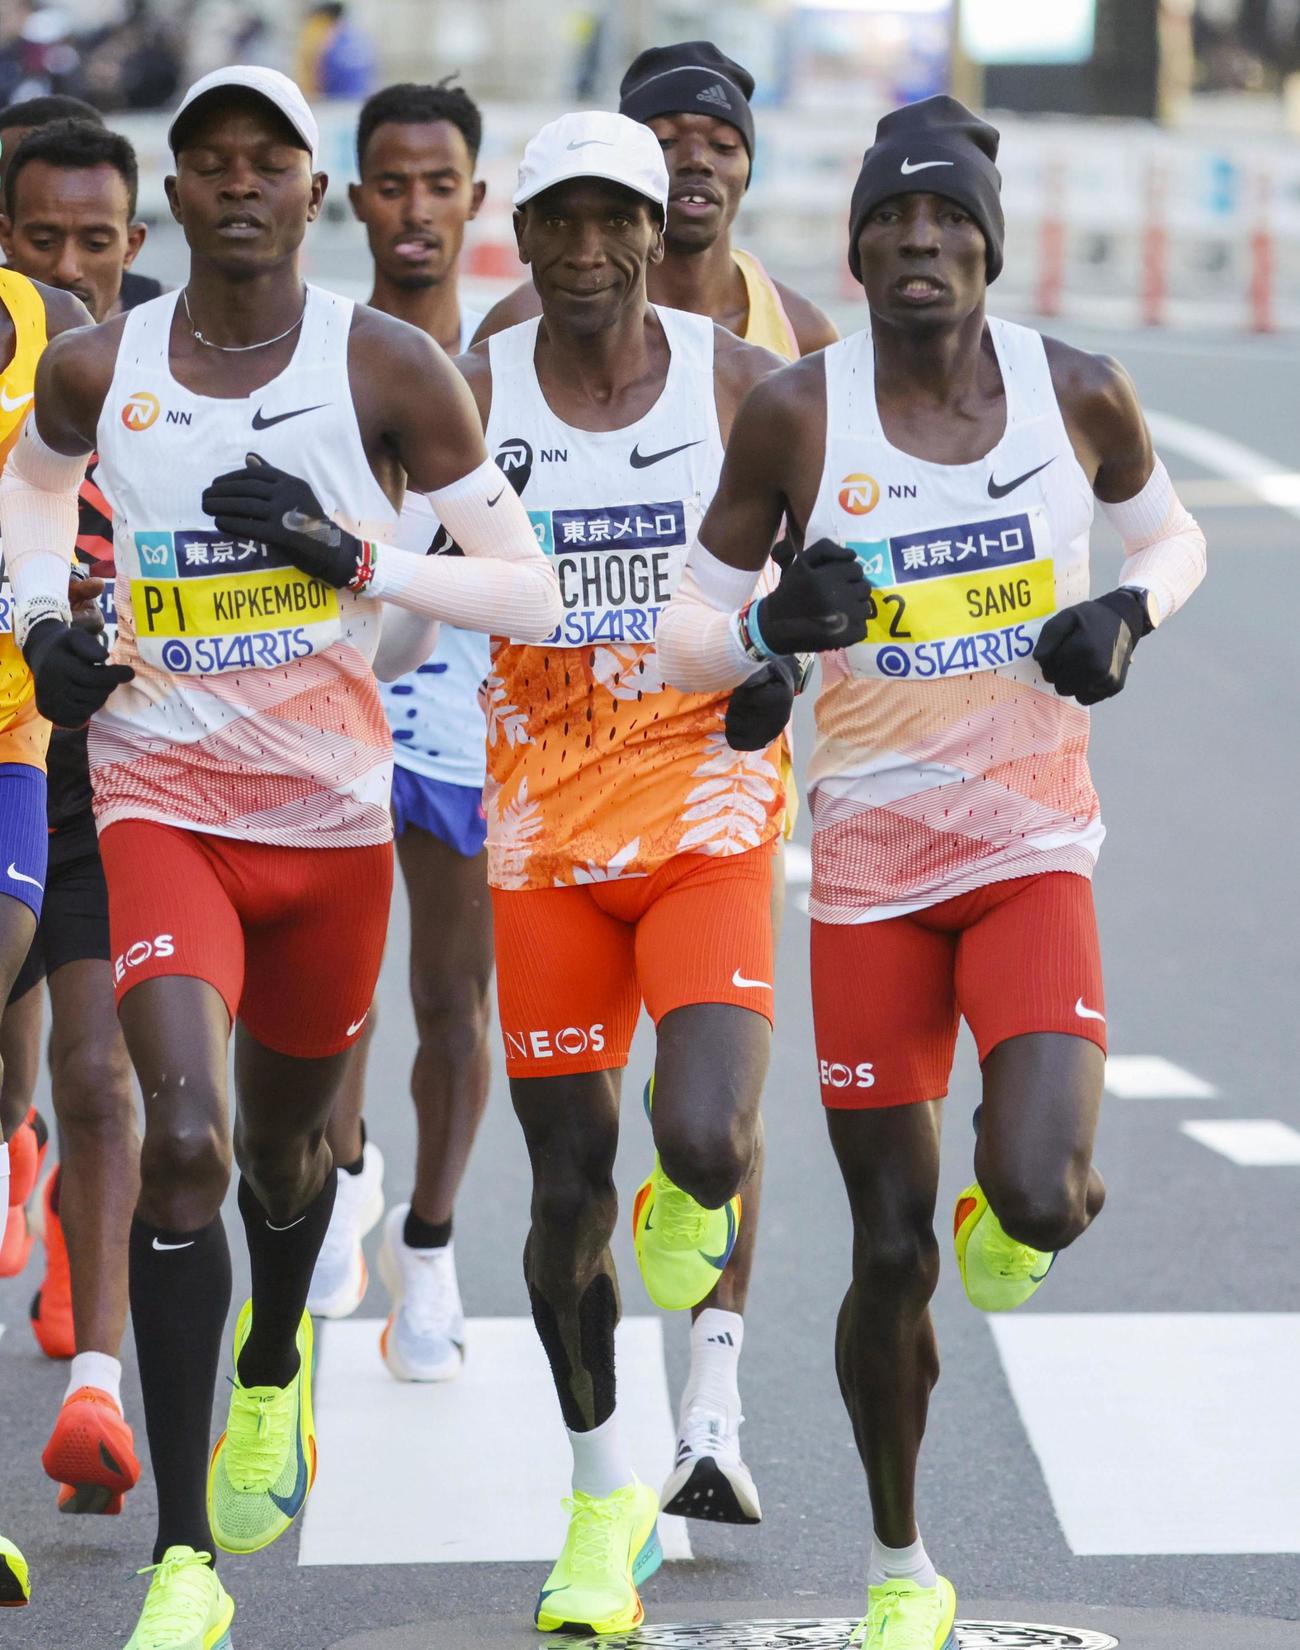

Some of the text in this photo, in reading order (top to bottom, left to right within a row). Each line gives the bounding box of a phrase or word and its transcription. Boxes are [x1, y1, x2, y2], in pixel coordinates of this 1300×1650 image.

[165, 410, 193, 426] NN
[540, 449, 568, 463] NN
[888, 485, 917, 498] NN
[562, 514, 676, 544] 東京メトロ
[901, 528, 1024, 571] 東京メトロ
[213, 578, 327, 621] KIPKEMBOI
[552, 552, 671, 609] CHOGE
[966, 579, 1032, 619] SANG
[565, 607, 662, 645] START
[113, 934, 175, 988] EOS
